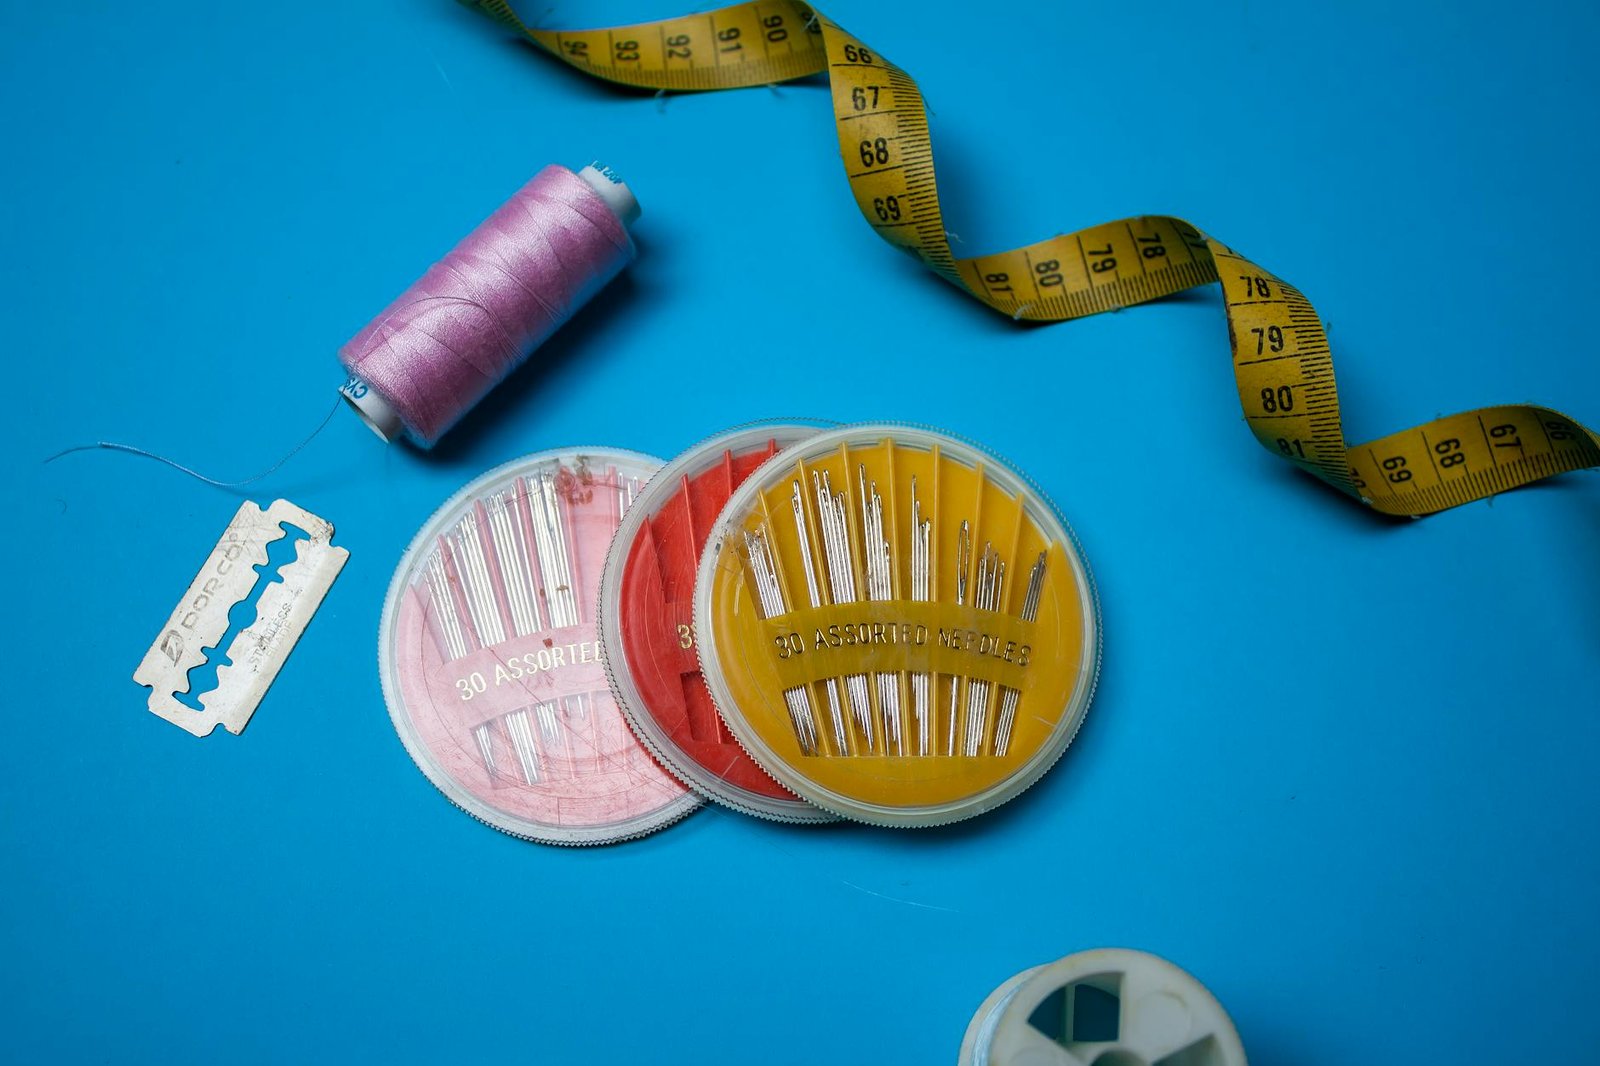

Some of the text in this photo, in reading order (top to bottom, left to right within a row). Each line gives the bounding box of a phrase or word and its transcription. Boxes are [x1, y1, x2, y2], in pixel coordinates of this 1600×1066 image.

[719, 27, 743, 54] 91
[763, 14, 788, 43] 90
[563, 40, 588, 58] 94
[615, 40, 640, 62] 93
[666, 34, 692, 60] 92
[844, 44, 872, 63] 66
[852, 86, 880, 111] 67
[859, 137, 889, 167] 68
[873, 195, 901, 221] 69
[1088, 243, 1117, 273] 79
[1137, 232, 1166, 260] 78
[984, 272, 1012, 293] 81
[1035, 259, 1063, 287] 80
[1239, 276, 1271, 299] 78
[1251, 325, 1284, 355] 79
[1260, 385, 1294, 413] 80
[1276, 438, 1306, 458] 81
[1490, 423, 1522, 449] 67
[1435, 438, 1465, 469] 68
[1383, 455, 1412, 484] 69
[180, 542, 244, 630] DORCO
[676, 623, 697, 649] 3
[774, 632, 805, 659] 30
[814, 622, 928, 651] ASSORTED
[455, 671, 487, 701] 30
